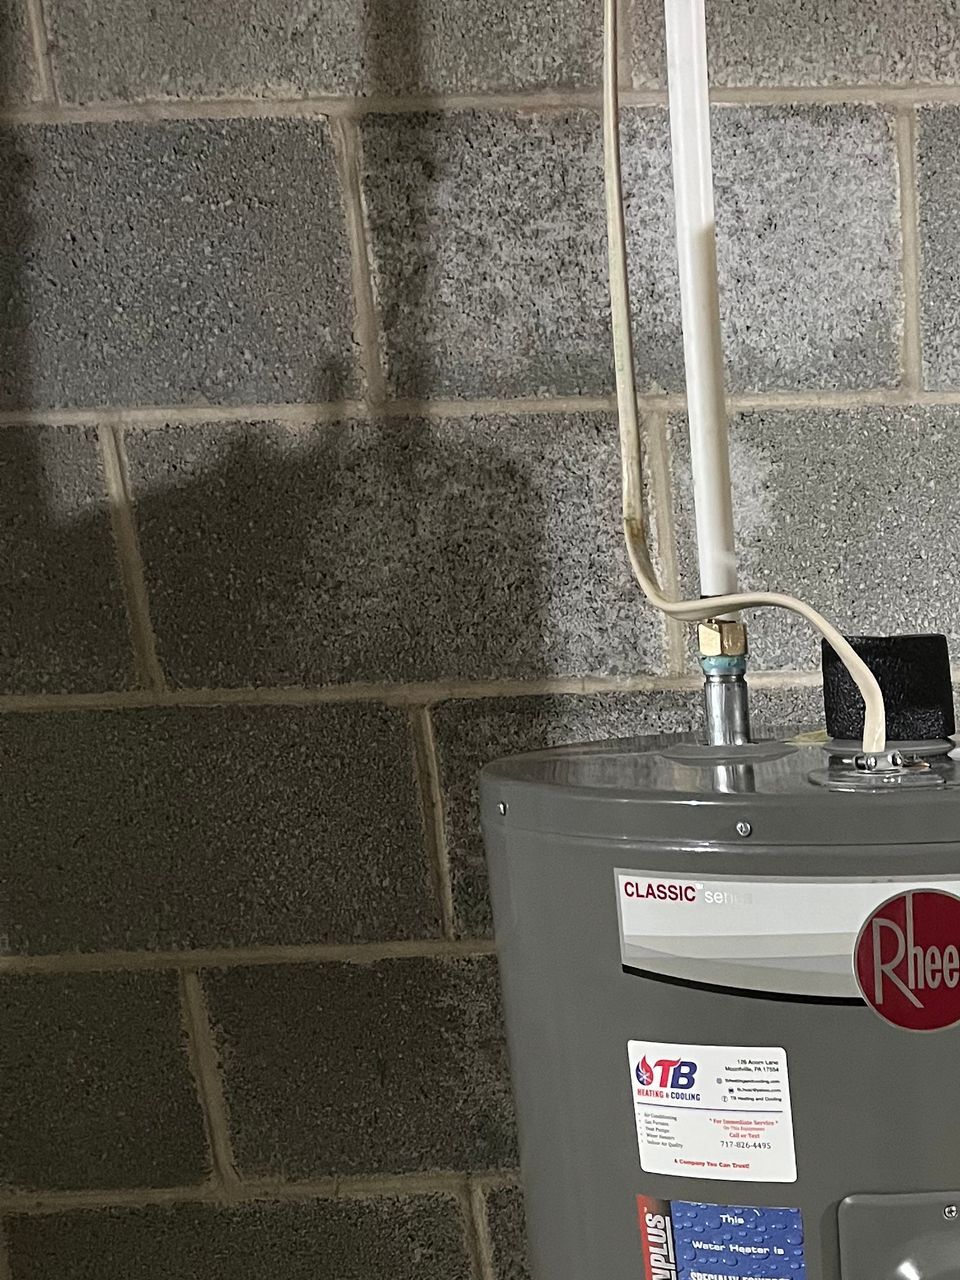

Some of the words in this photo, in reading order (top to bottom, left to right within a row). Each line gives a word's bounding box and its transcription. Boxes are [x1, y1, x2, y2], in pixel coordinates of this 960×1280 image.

[624, 882, 696, 902] CLASSIC
[653, 1058, 697, 1090] TB
[637, 1089, 664, 1099] HEATING
[670, 1091, 701, 1101] COOLING
[721, 1141, 771, 1149] 717-826-4495
[680, 1159, 705, 1167] Company
[720, 1214, 744, 1225] This
[692, 1240, 726, 1251] Water
[730, 1244, 770, 1254] Heater
